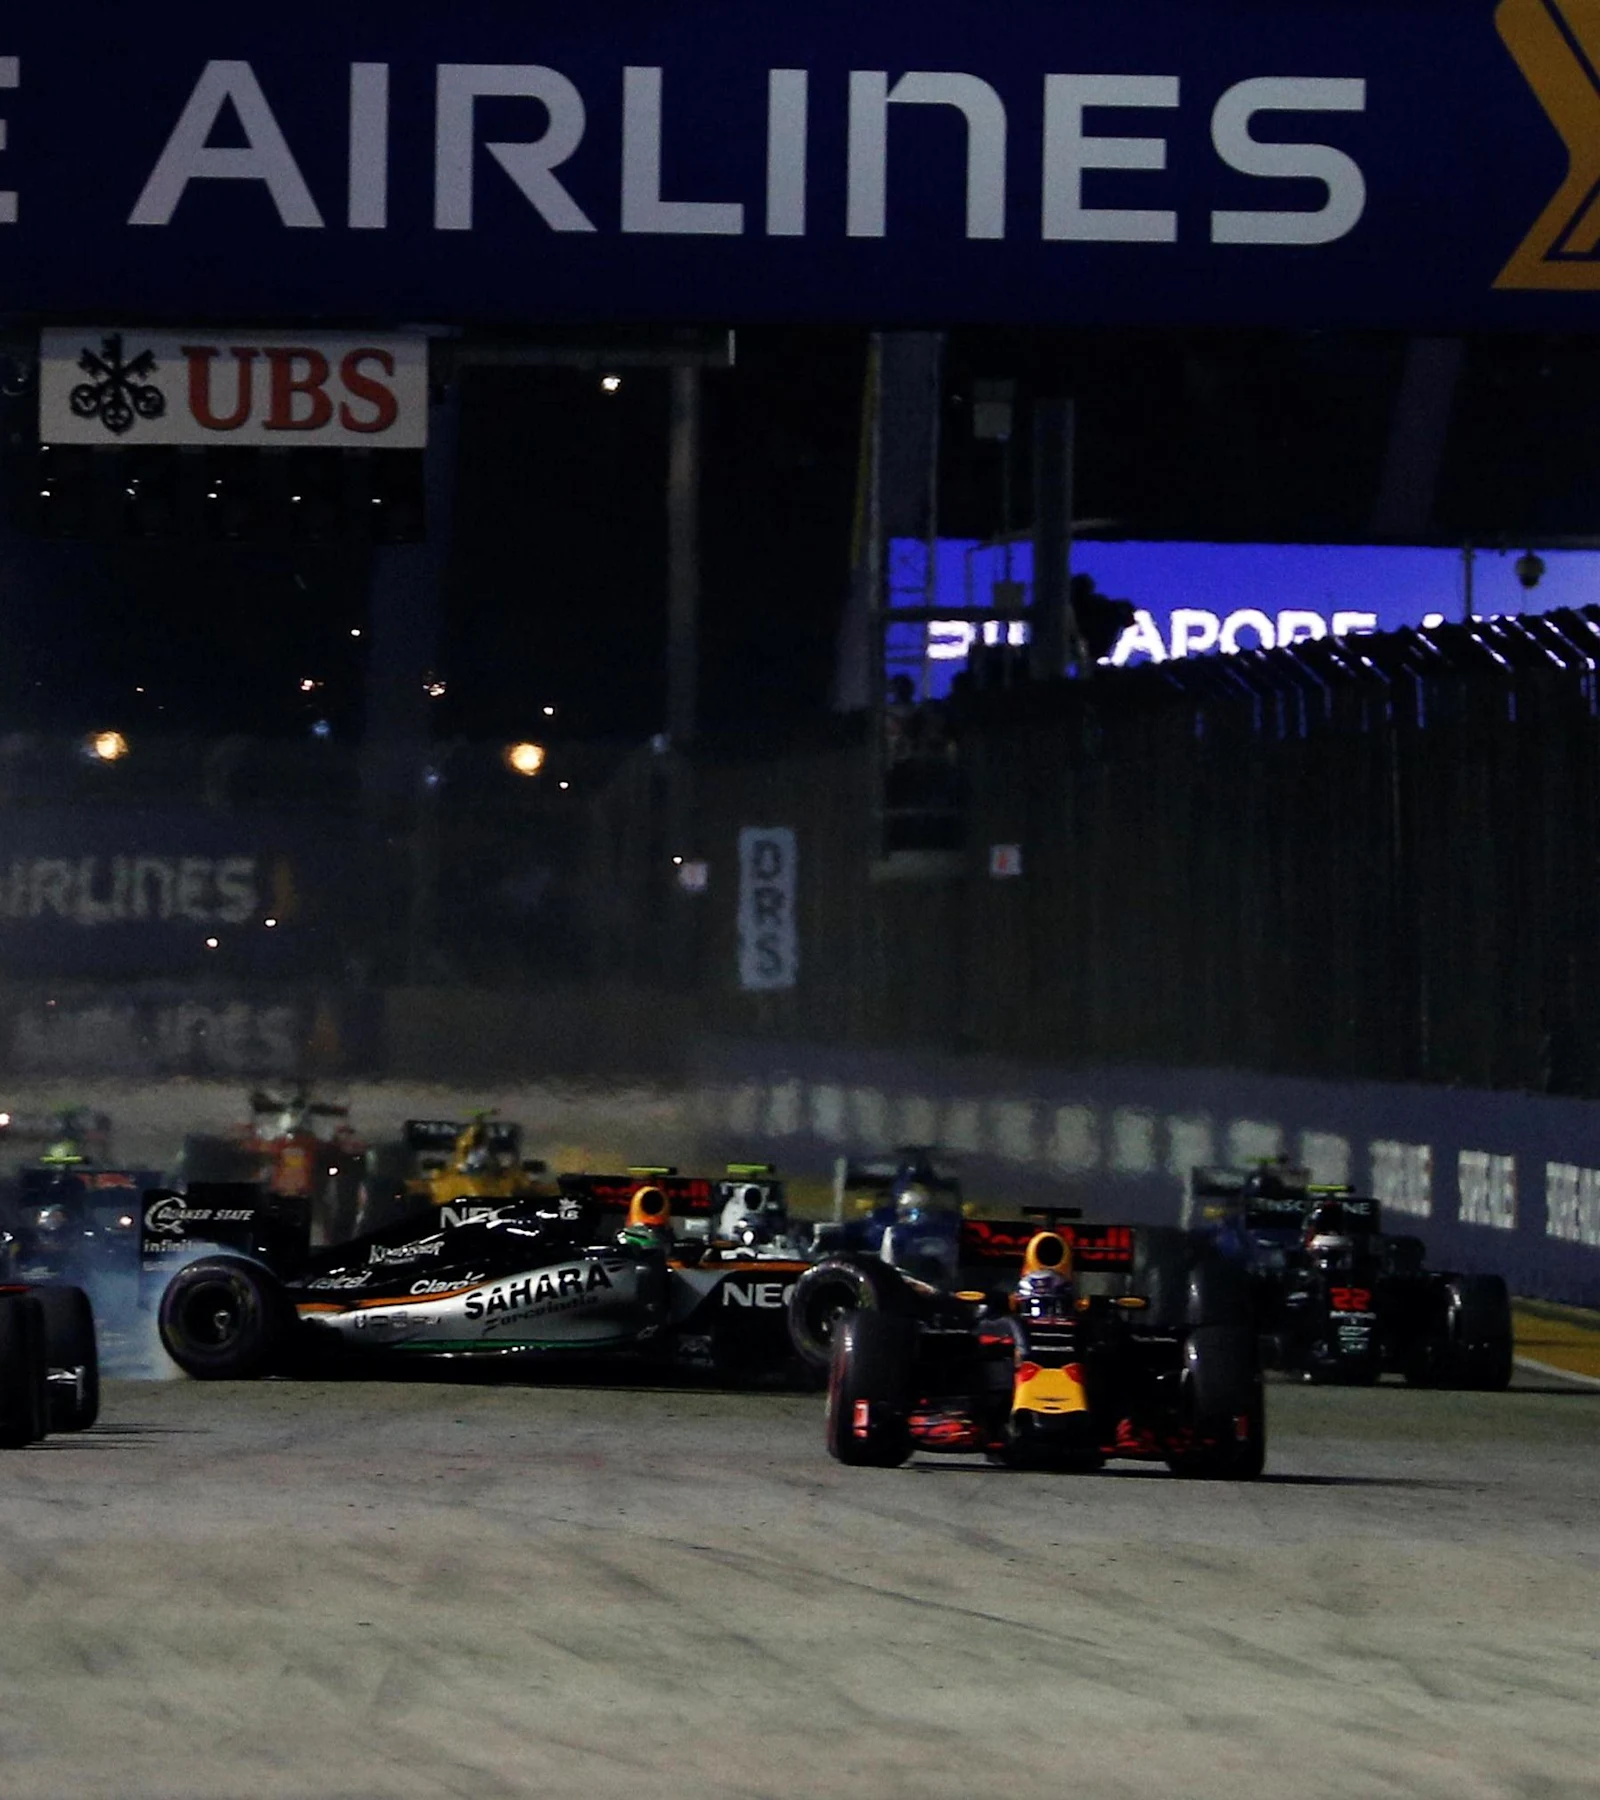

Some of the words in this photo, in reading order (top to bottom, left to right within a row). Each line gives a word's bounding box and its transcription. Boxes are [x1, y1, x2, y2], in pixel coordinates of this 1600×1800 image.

[126, 58, 1366, 244] AIRLINES
[181, 346, 398, 434] UBS
[752, 838, 788, 978] DRS
[213, 1208, 255, 1221] STATE
[465, 1264, 613, 1319] SAHARA
[1328, 1286, 1373, 1312] 22
